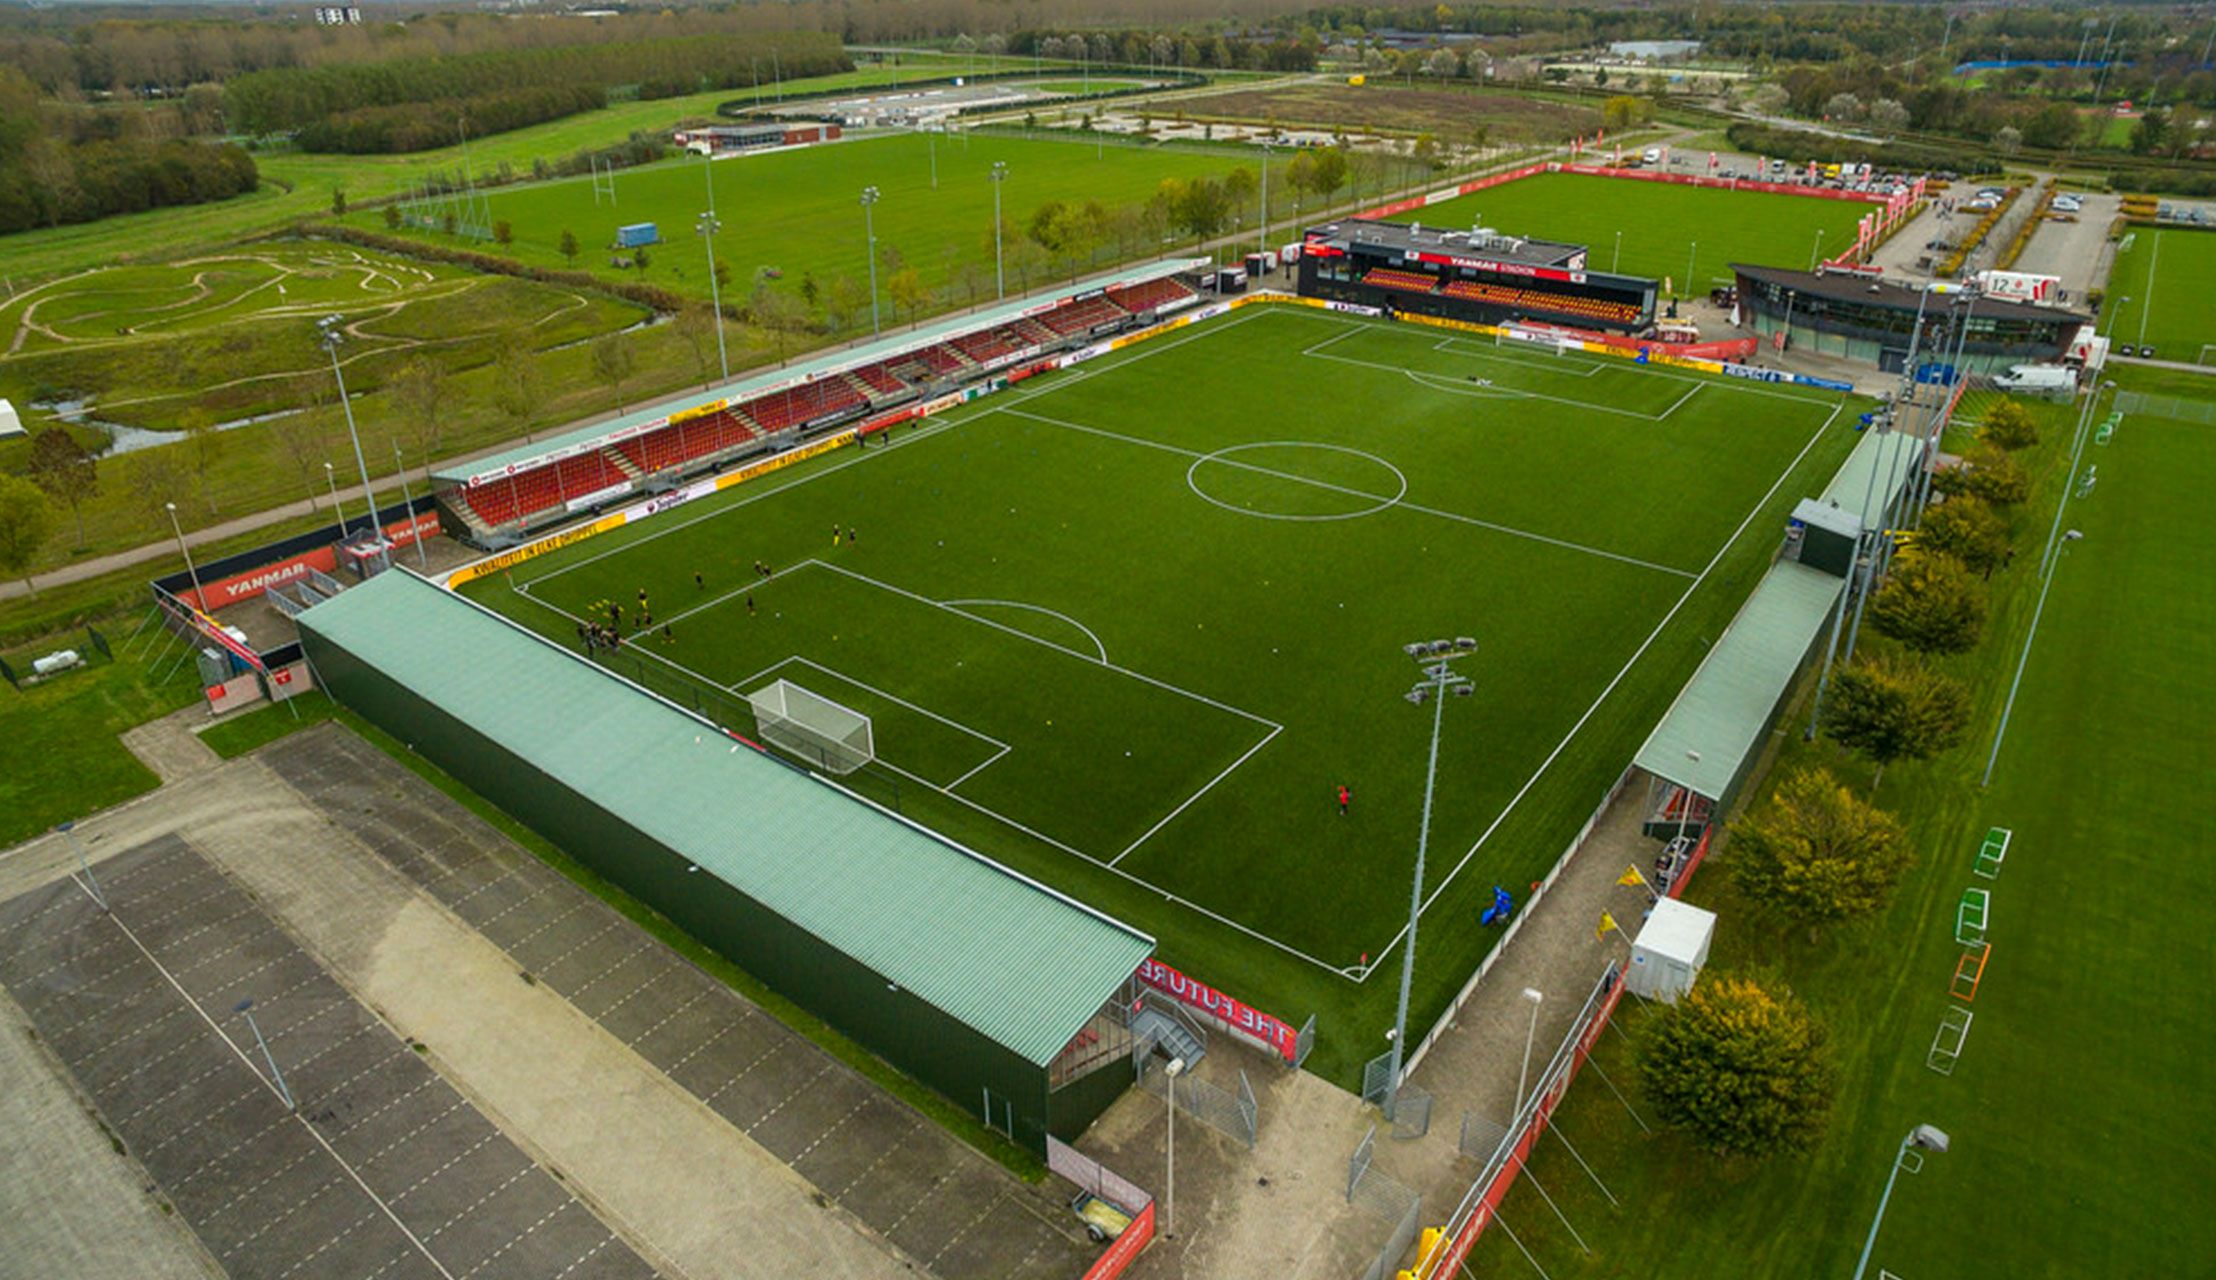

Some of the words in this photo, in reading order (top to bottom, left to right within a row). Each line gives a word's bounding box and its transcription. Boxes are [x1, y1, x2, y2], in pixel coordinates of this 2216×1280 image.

[1450, 256, 1497, 271] YANMAR
[1992, 278, 2009, 292] 12
[226, 562, 305, 597] YANMAR
